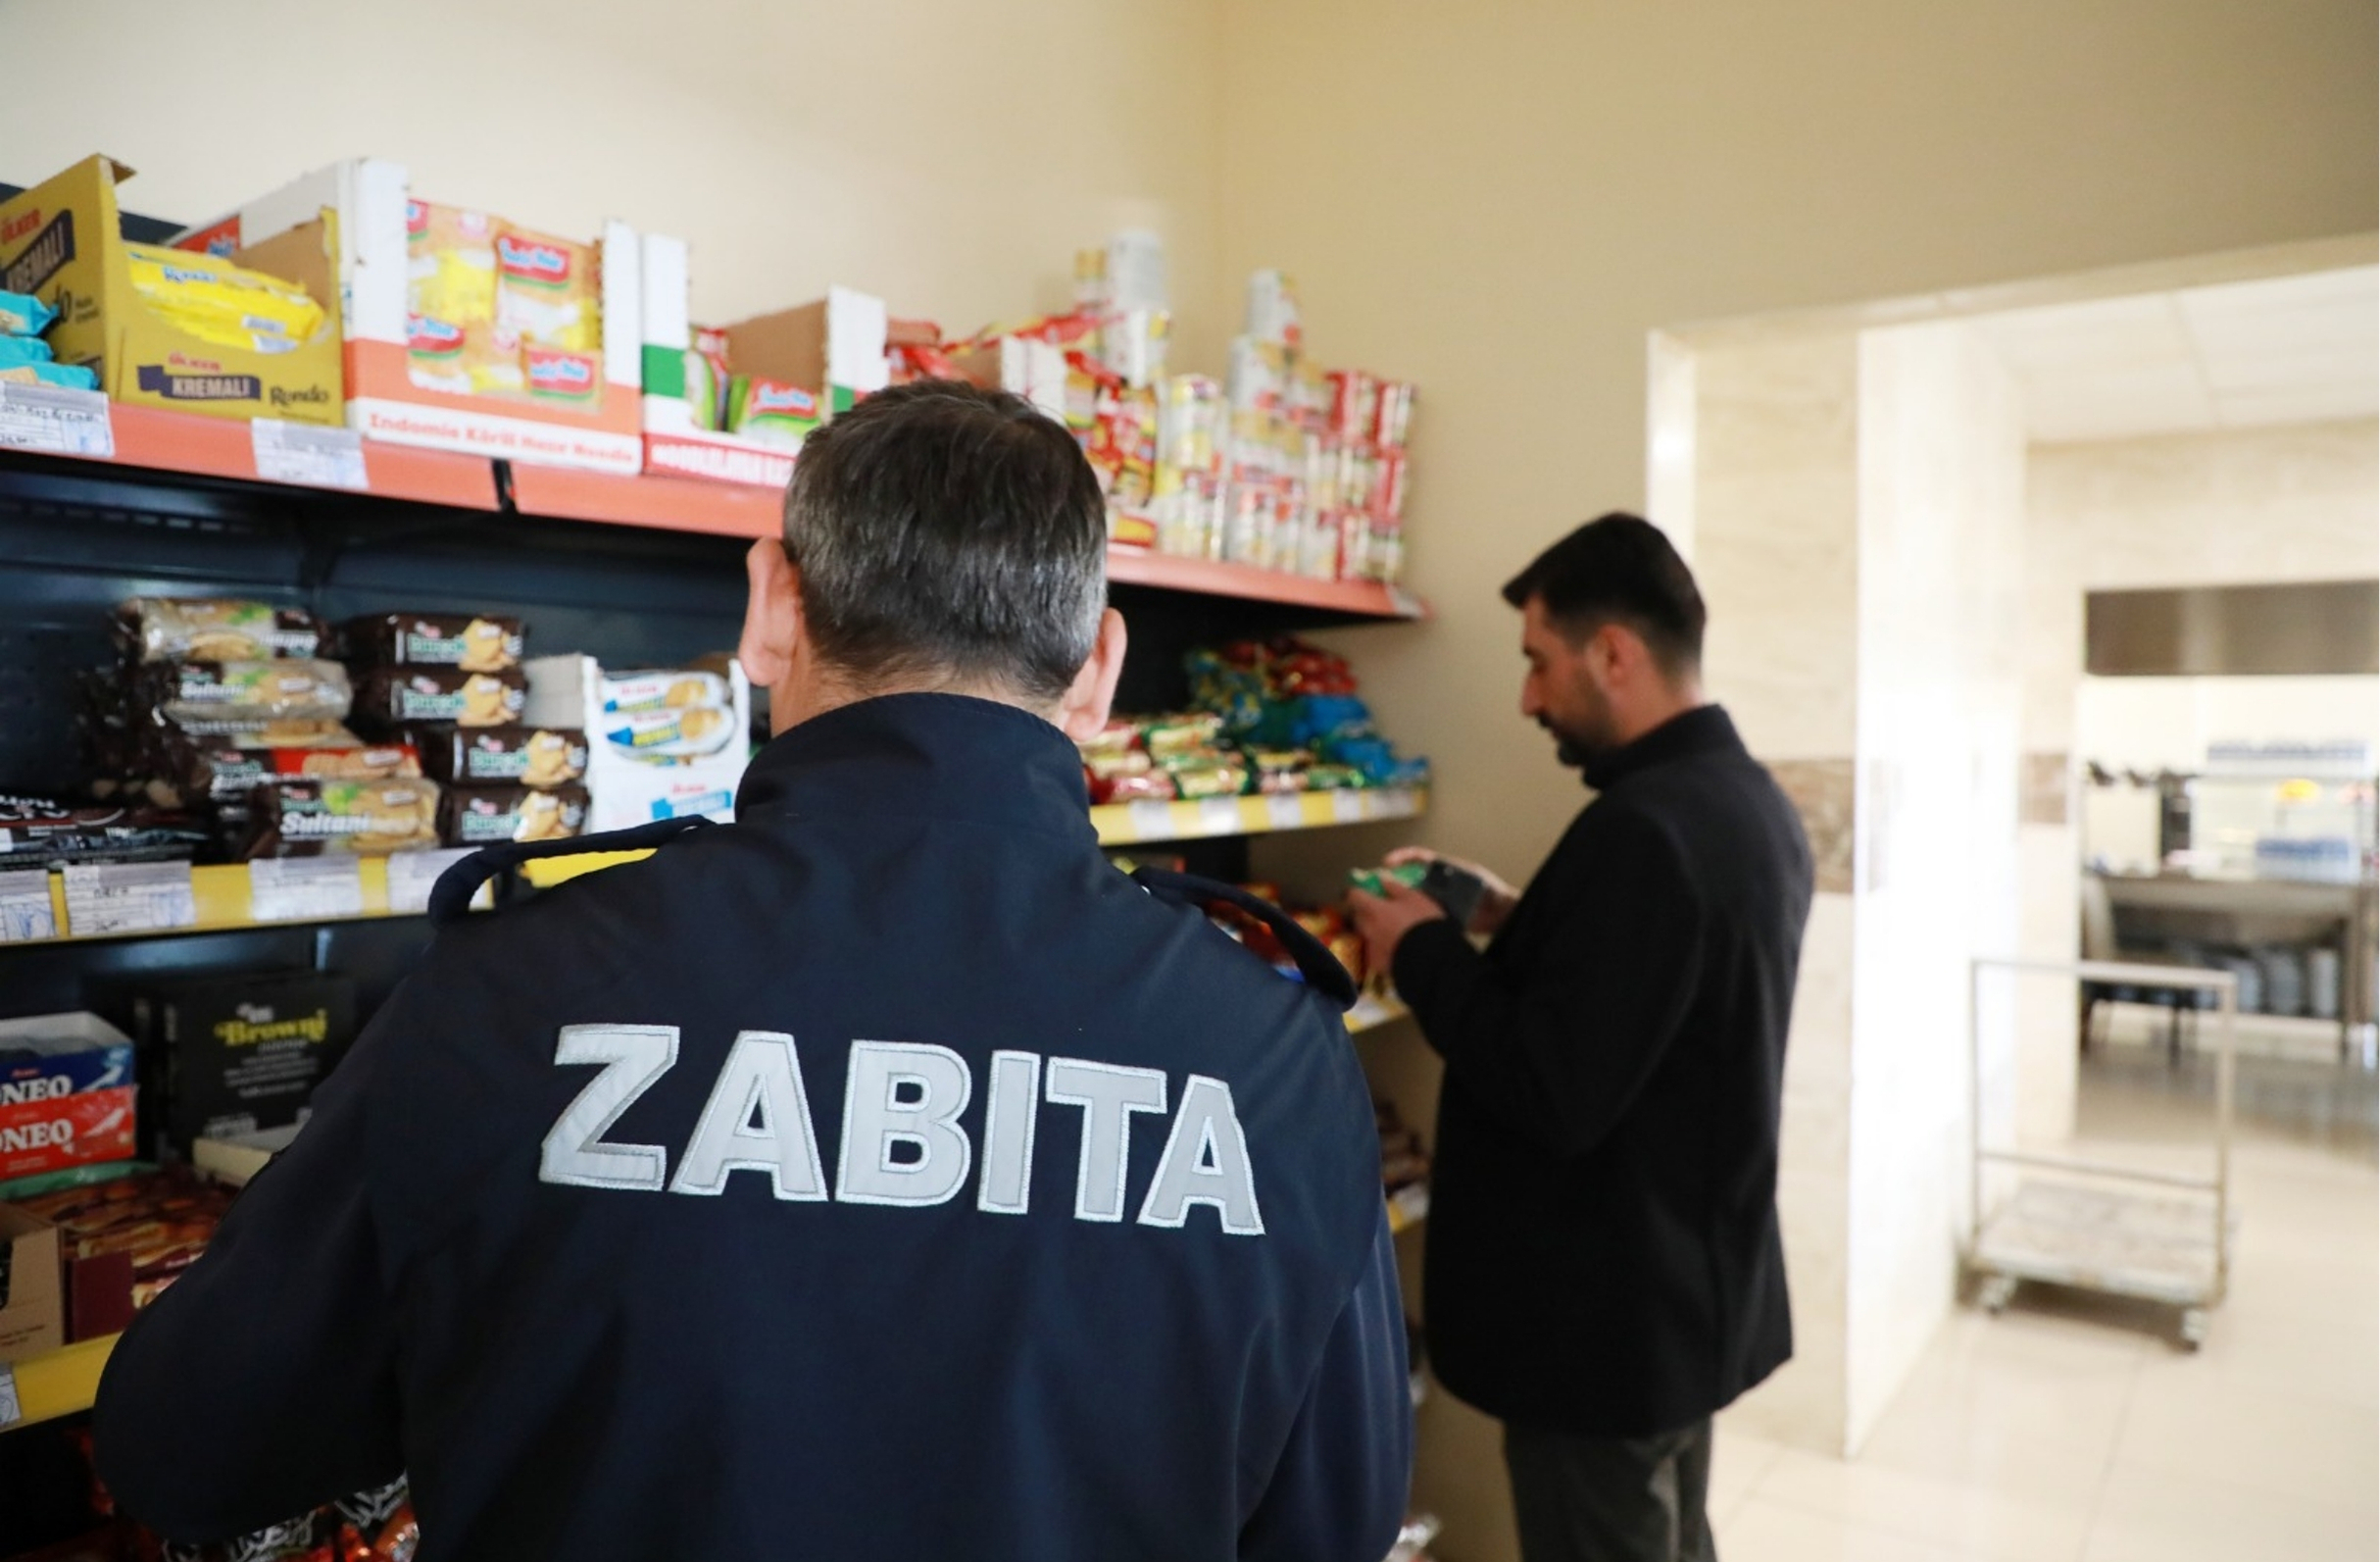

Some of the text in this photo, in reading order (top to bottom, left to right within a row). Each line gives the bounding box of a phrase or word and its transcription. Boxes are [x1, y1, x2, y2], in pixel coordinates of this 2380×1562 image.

[172, 377, 251, 398] KREMALI
[369, 413, 460, 439] Indomie
[279, 810, 371, 835] Sultani
[0, 1075, 73, 1108] NEO
[0, 1118, 74, 1154] NEO
[539, 1023, 1265, 1235] ZABITA
